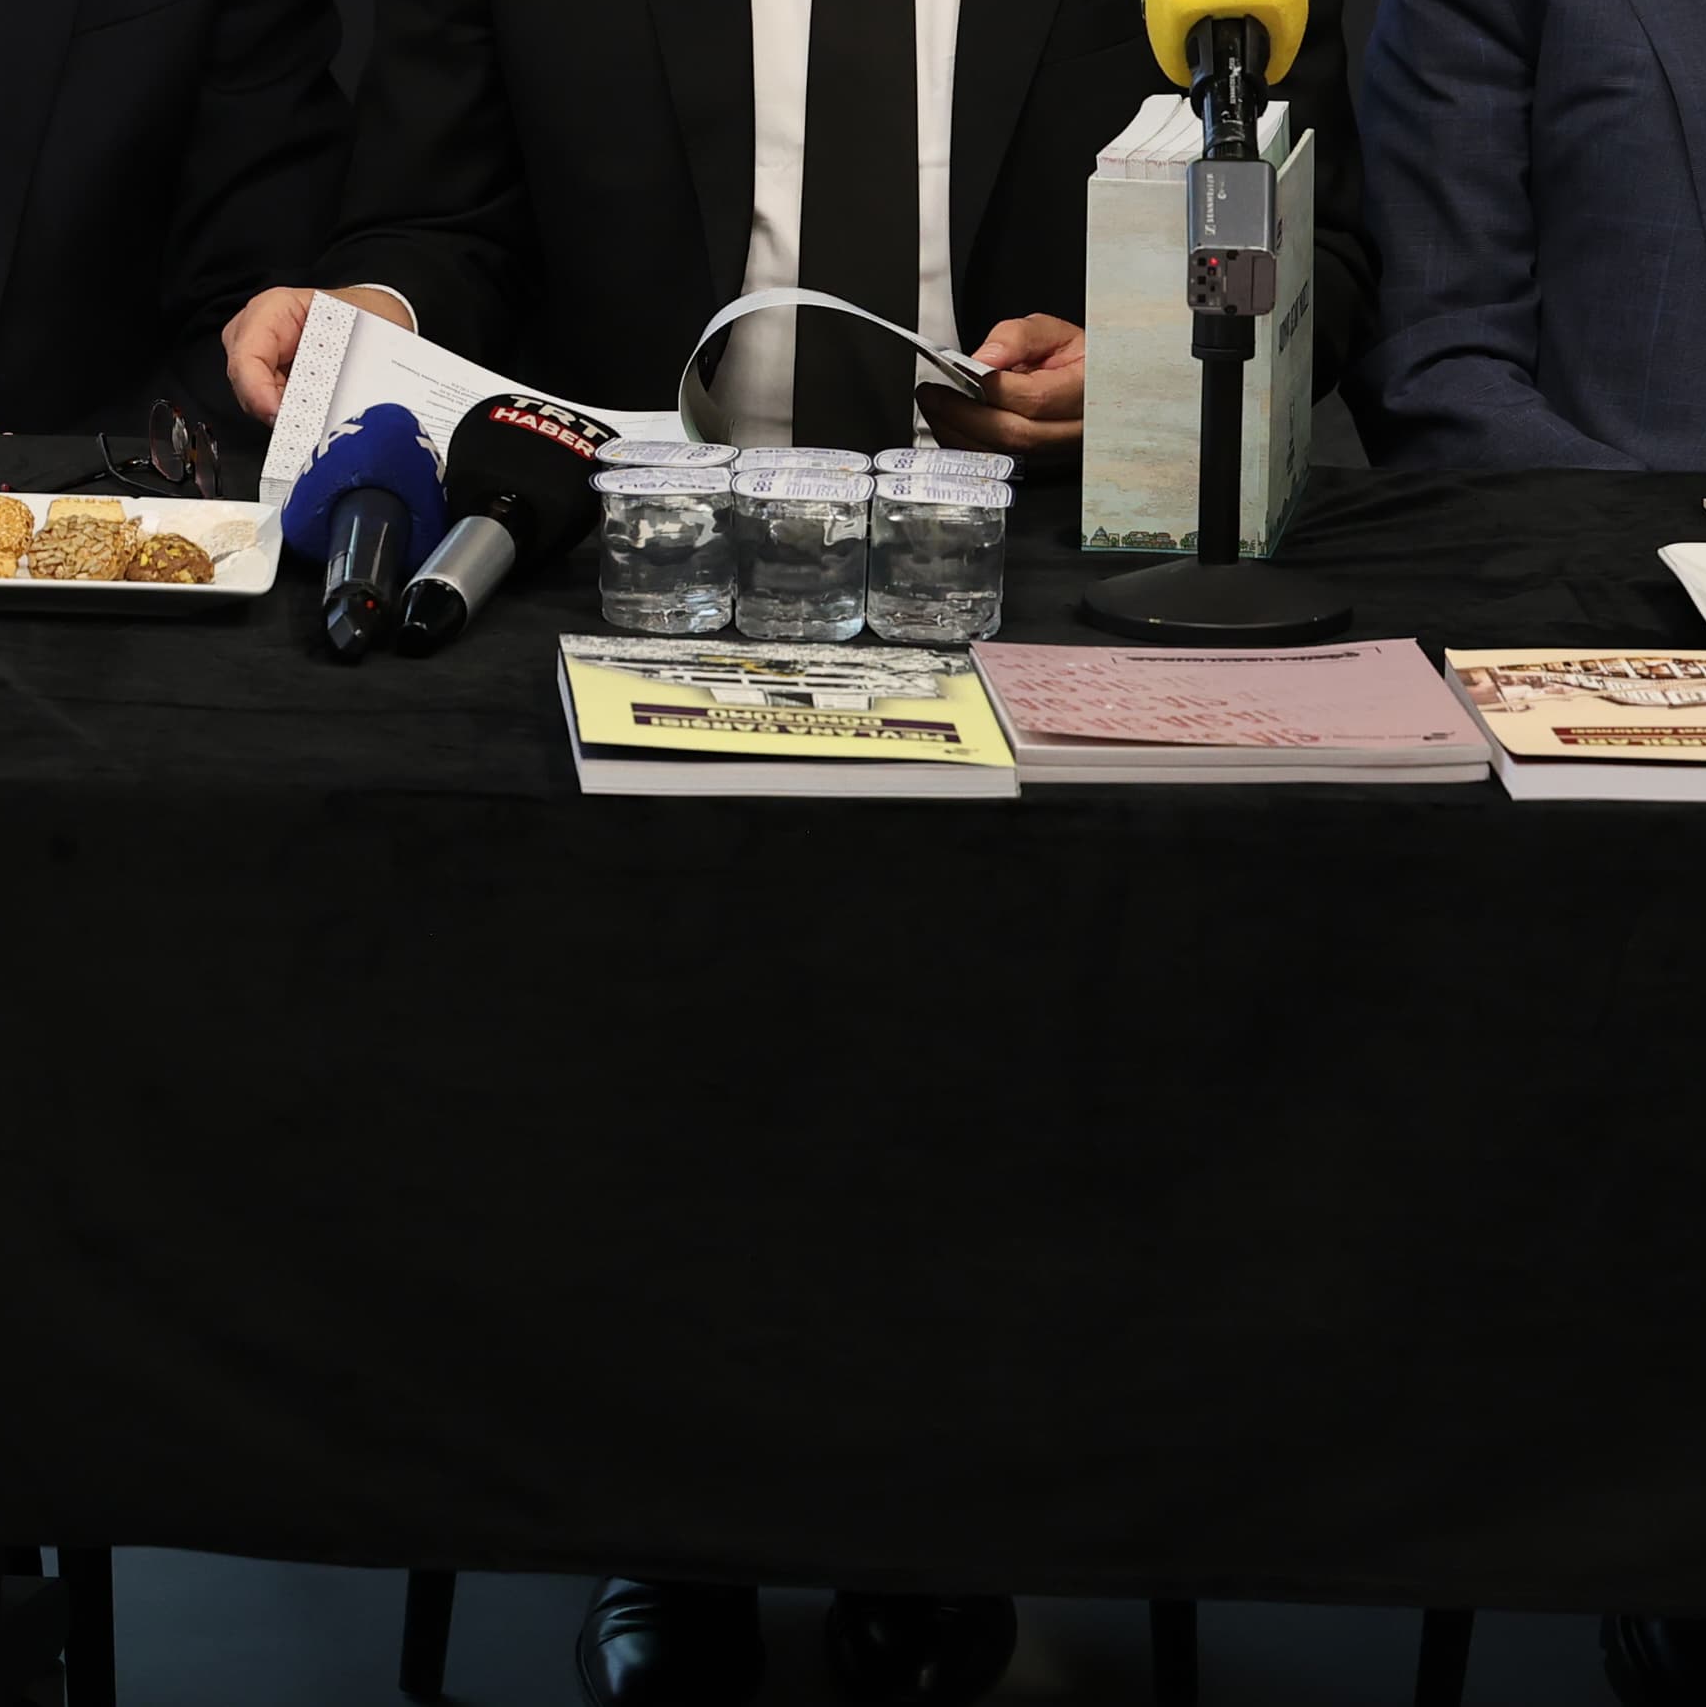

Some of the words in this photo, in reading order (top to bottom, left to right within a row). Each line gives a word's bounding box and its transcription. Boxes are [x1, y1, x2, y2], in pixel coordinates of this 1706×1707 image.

[493, 407, 597, 459] HABER
[508, 395, 610, 440] TRT
[787, 725, 946, 742] MEVLANA
